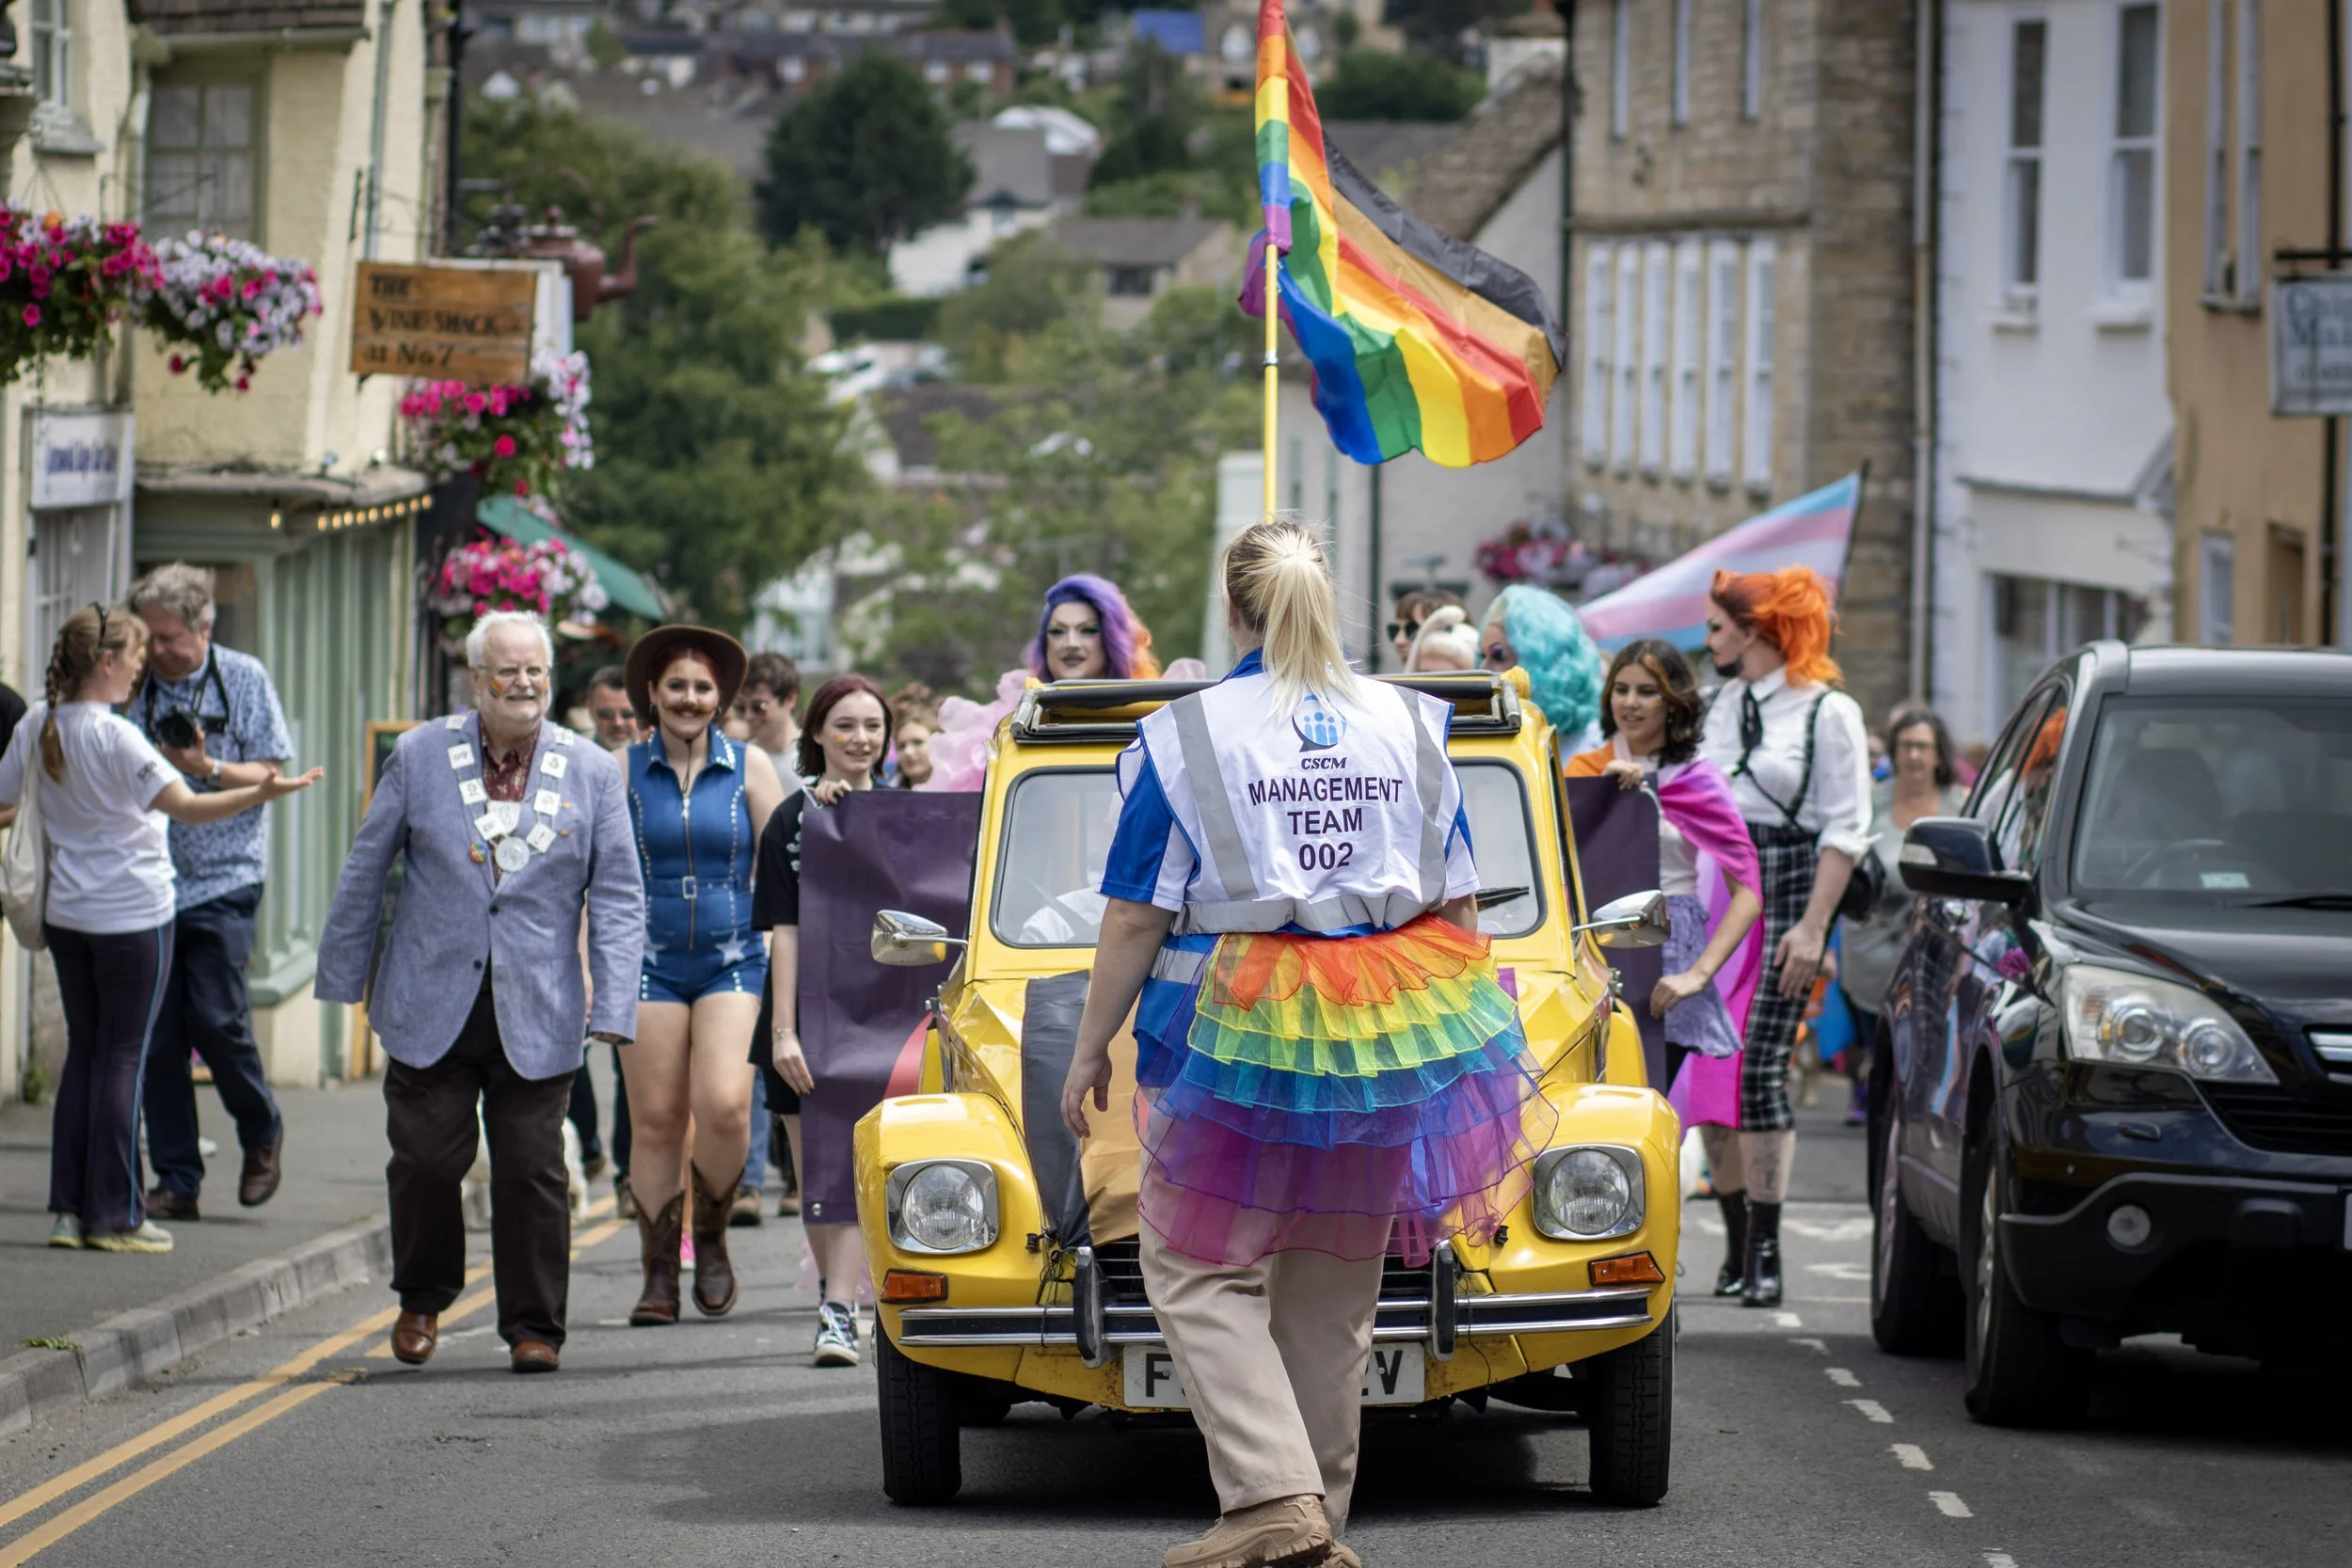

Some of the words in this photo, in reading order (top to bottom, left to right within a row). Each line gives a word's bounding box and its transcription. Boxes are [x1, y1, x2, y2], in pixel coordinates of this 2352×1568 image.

[1301, 756, 1348, 770] CSCM
[1248, 776, 1404, 807] MANAGEMENT
[1287, 807, 1363, 835] TEAM
[1298, 842, 1355, 871] 002
